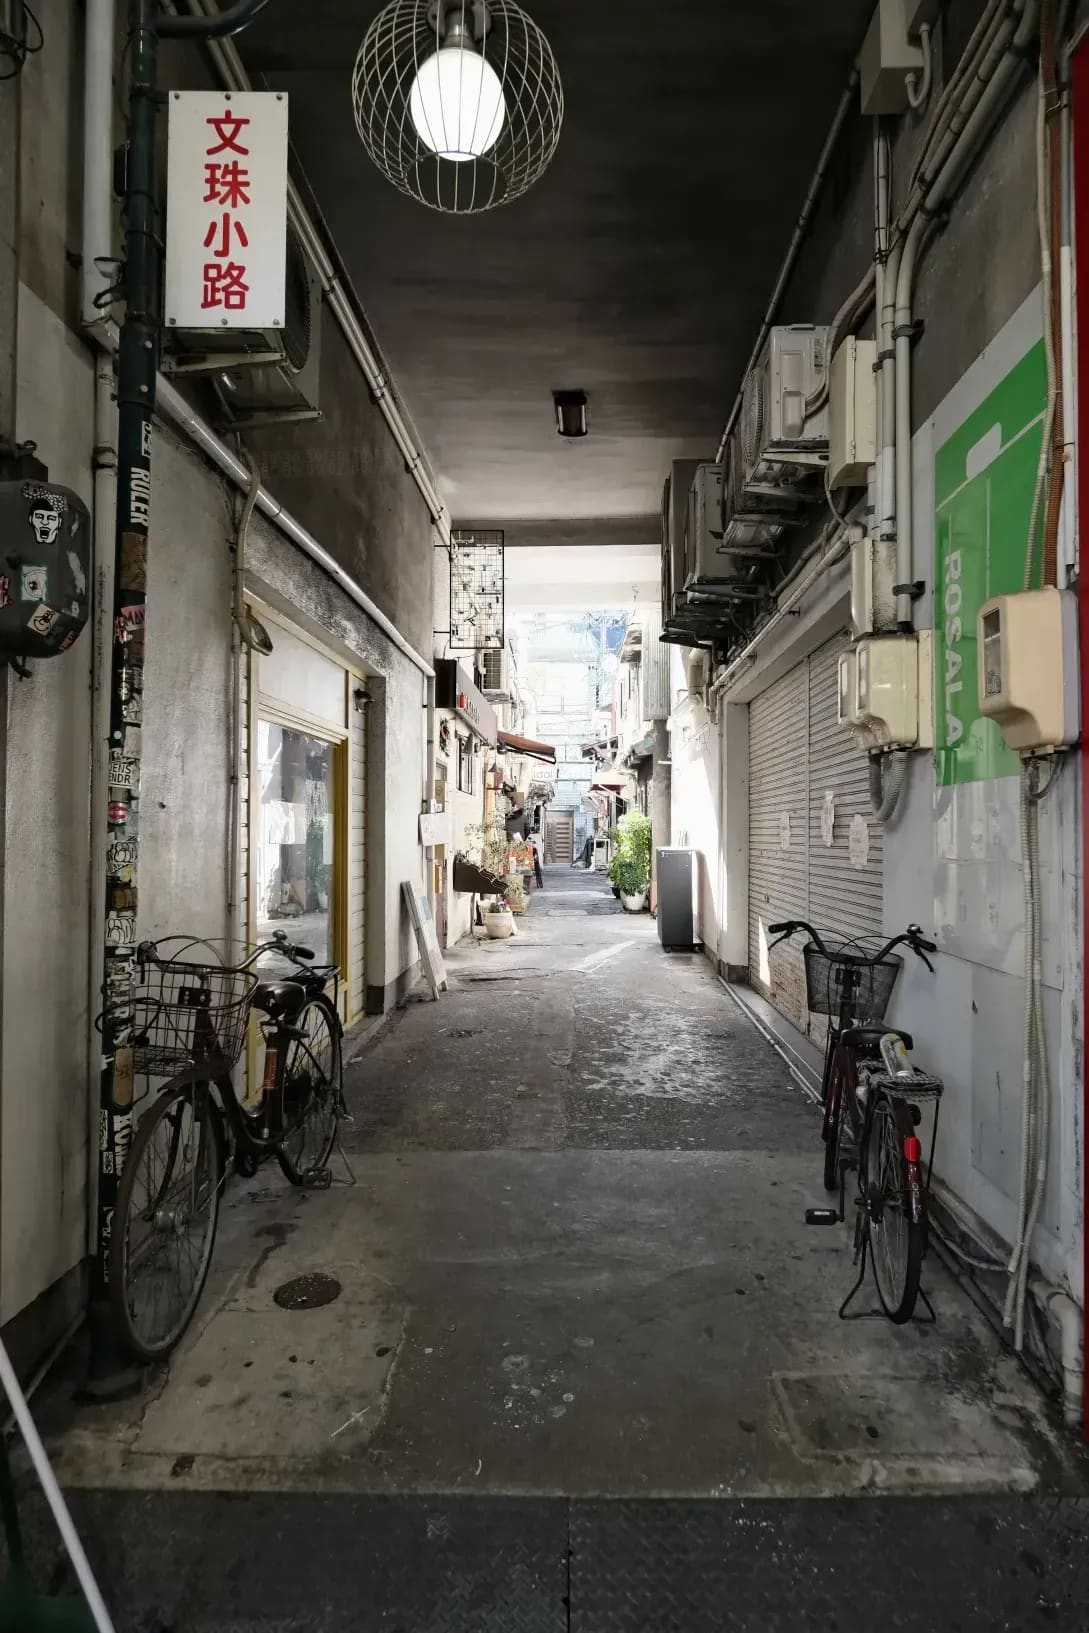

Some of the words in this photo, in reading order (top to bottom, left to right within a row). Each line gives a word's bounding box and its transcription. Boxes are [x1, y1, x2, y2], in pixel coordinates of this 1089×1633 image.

[202, 110, 250, 309] 文珠小路
[945, 550, 963, 746] ROSALA
